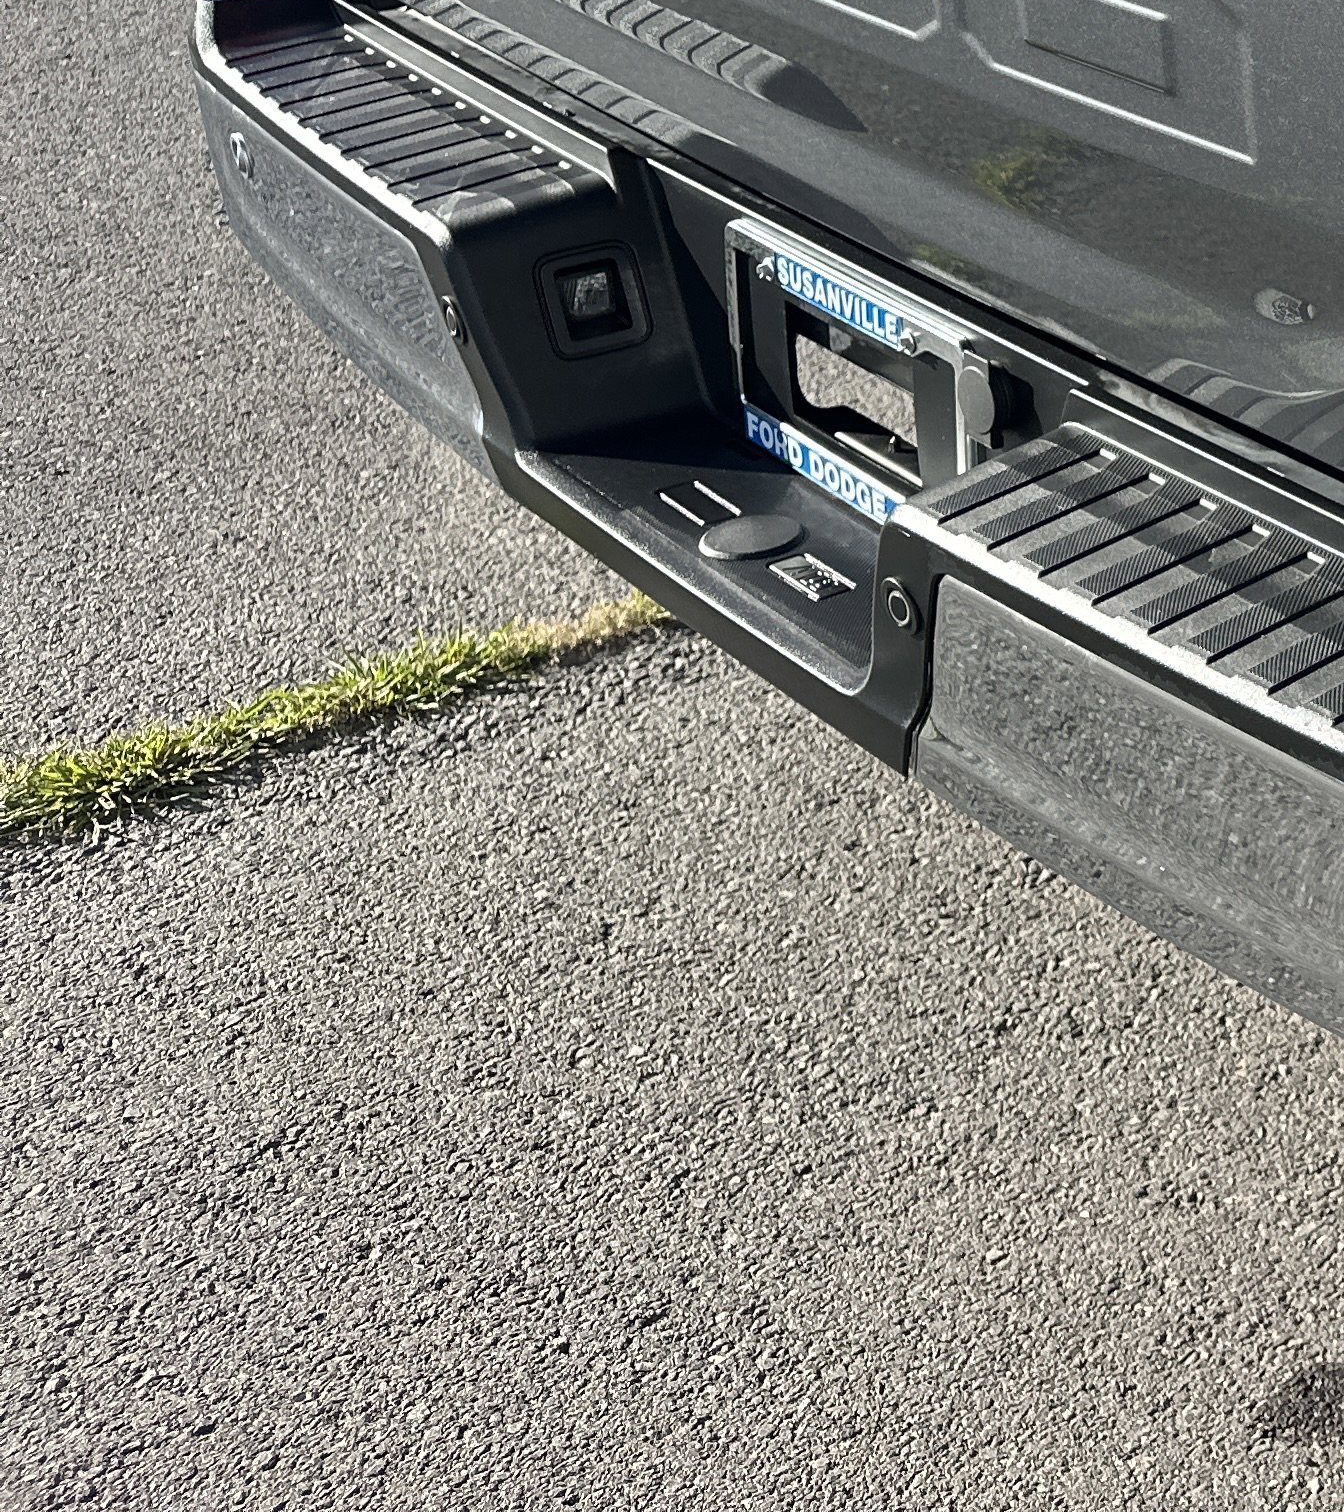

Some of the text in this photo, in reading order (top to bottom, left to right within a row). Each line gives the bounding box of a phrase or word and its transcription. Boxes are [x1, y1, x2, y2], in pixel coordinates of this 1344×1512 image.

[777, 255, 898, 340] SUSANVILLE
[746, 411, 888, 518] FORD DODGE
